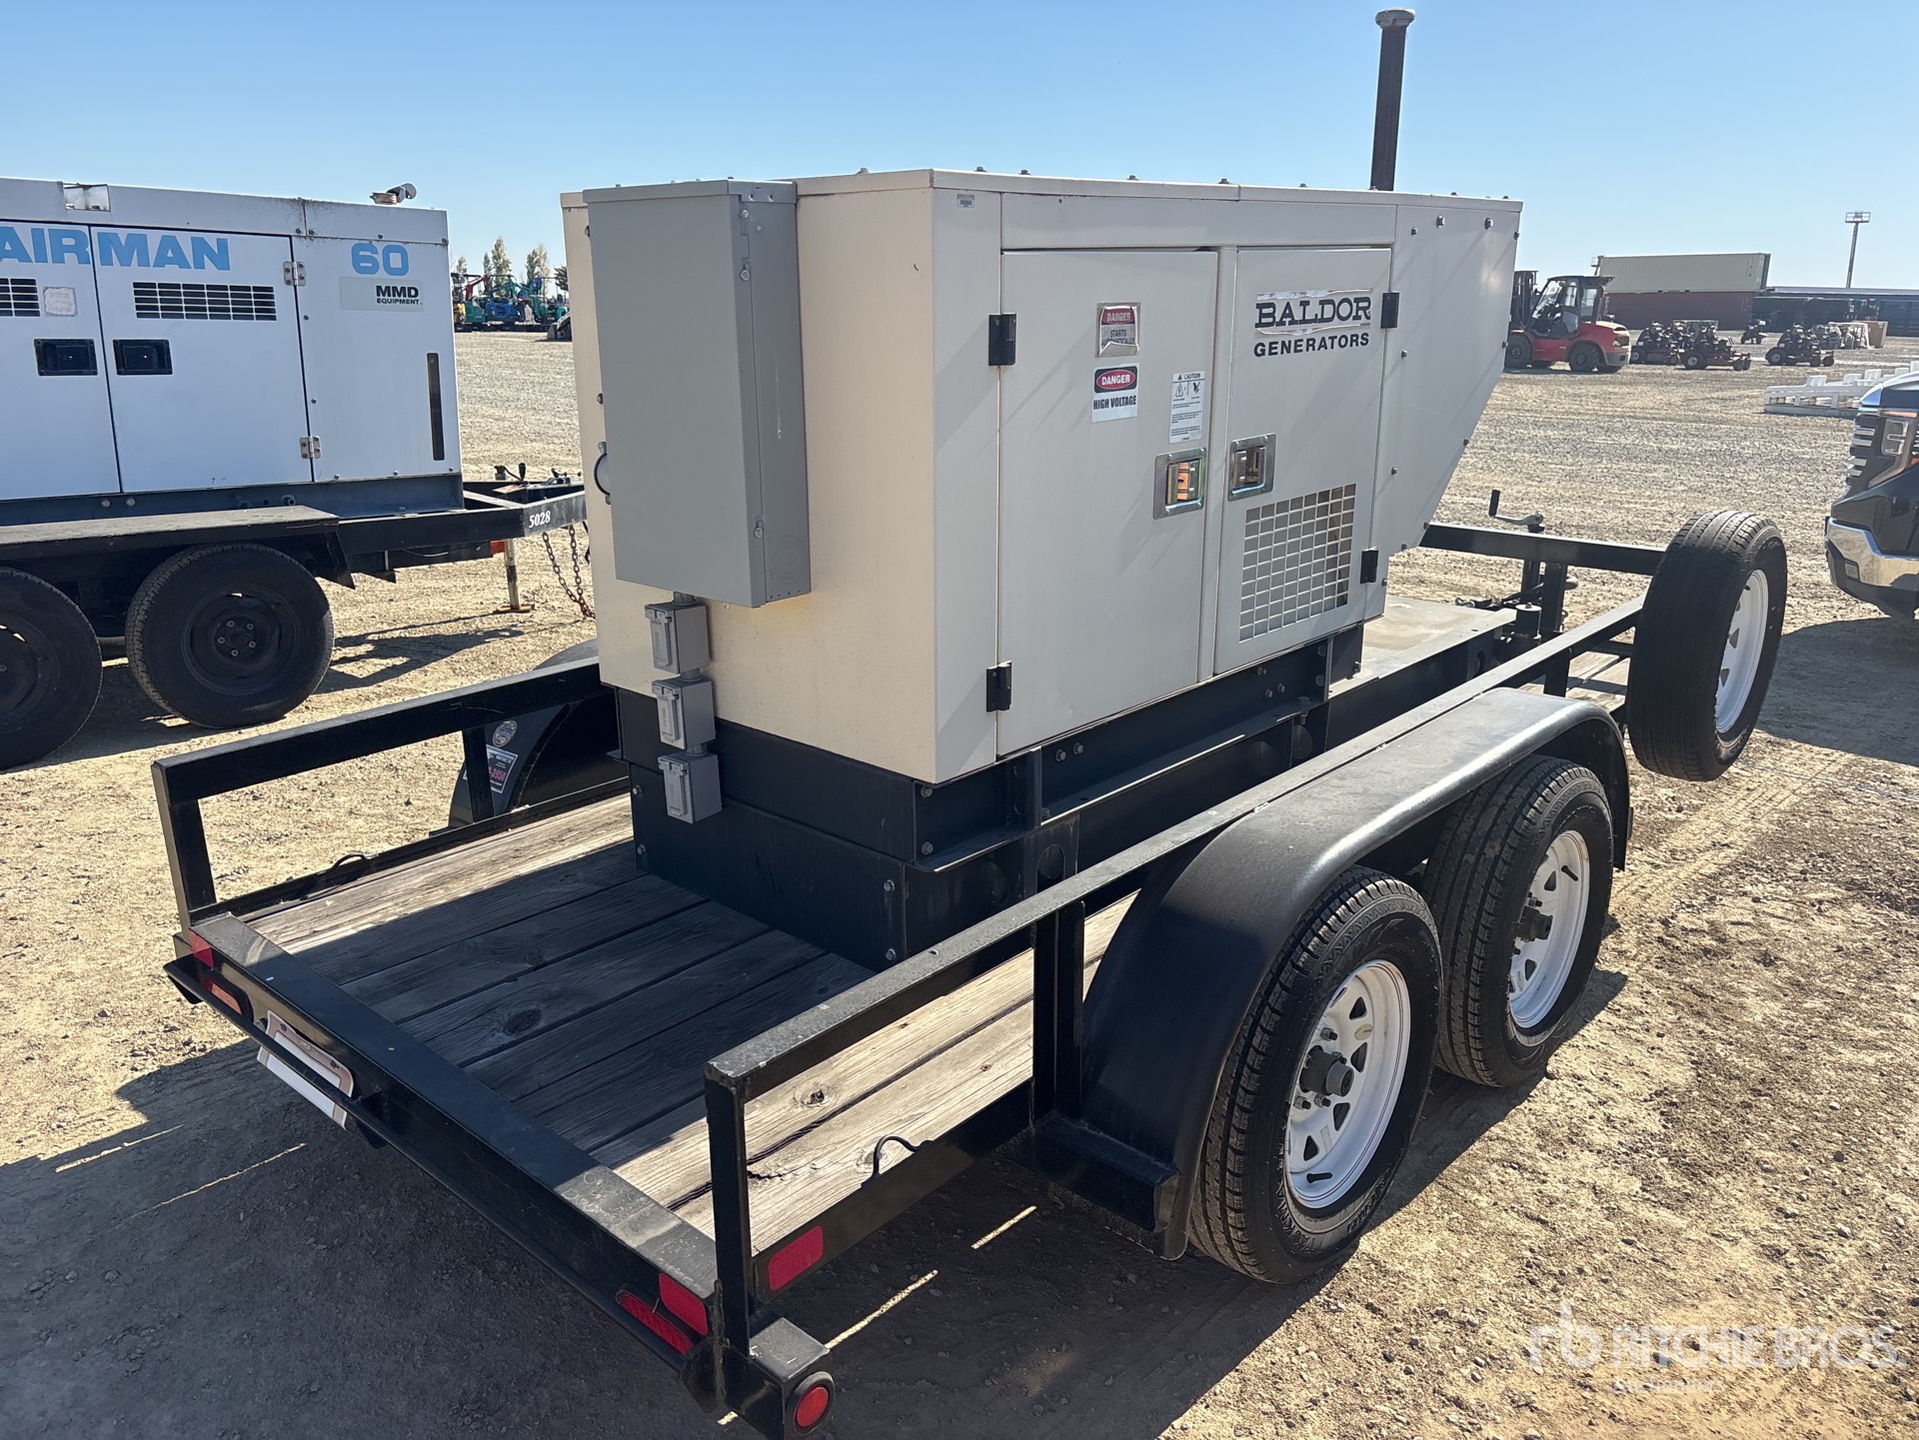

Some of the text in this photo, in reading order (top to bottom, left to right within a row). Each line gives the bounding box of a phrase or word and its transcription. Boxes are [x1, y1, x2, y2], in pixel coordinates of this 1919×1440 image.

[0, 226, 231, 271] AIRMAN
[351, 242, 410, 277] 60
[375, 285, 419, 298] MMD
[376, 297, 420, 305] EQUIPMENT
[1106, 312, 1131, 322] DANGER
[1254, 297, 1371, 328] BALDOR
[1253, 332, 1370, 358] GENERATORS
[1101, 374, 1131, 386] DANGER
[1183, 372, 1201, 380] CAUTION
[1093, 395, 1137, 410] HIGH VOLTAGE
[528, 510, 551, 529] 5028
